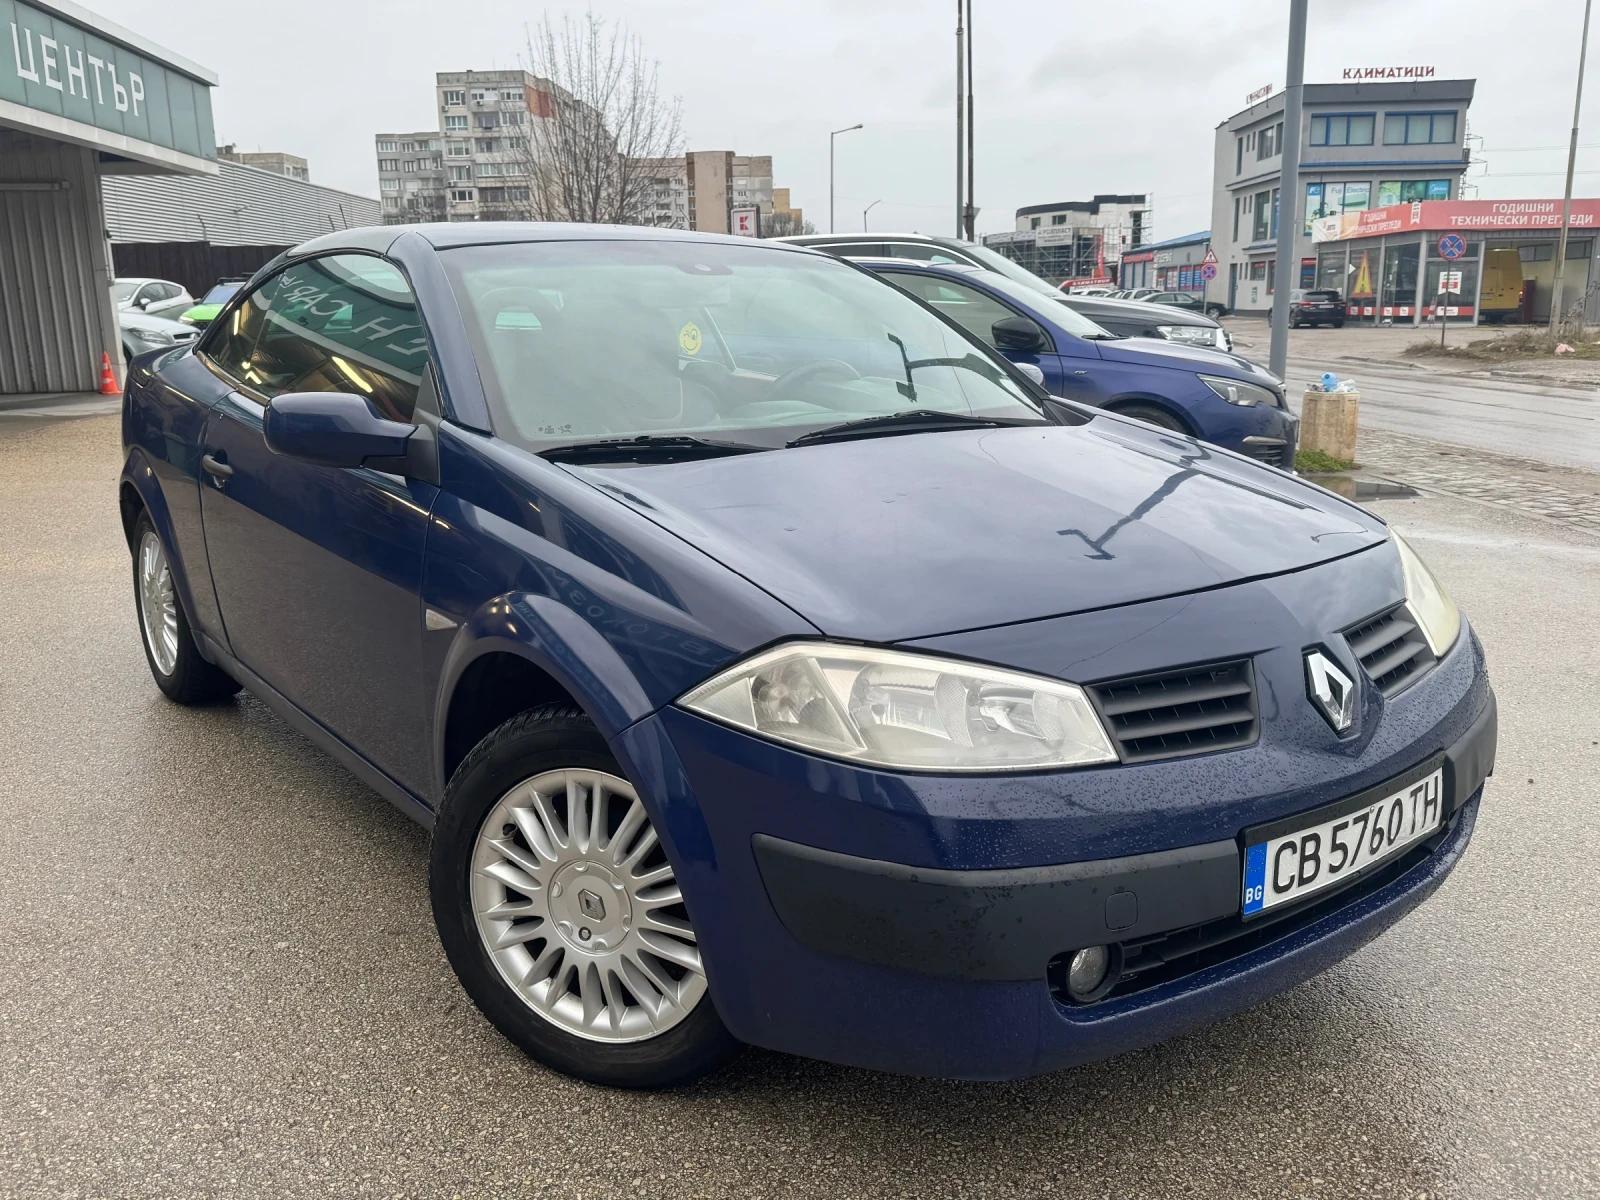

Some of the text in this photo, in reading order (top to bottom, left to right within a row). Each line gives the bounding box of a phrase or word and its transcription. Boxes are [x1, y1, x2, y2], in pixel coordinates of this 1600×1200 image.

[10, 22, 145, 117] ЦЕНТЪР
[1343, 66, 1434, 79] КЛИМАТИЦИ
[1492, 203, 1554, 213] ГОДИШНИ
[1451, 215, 1528, 226] ТЕХНИЧЕСКИ
[1245, 885, 1263, 904] BG
